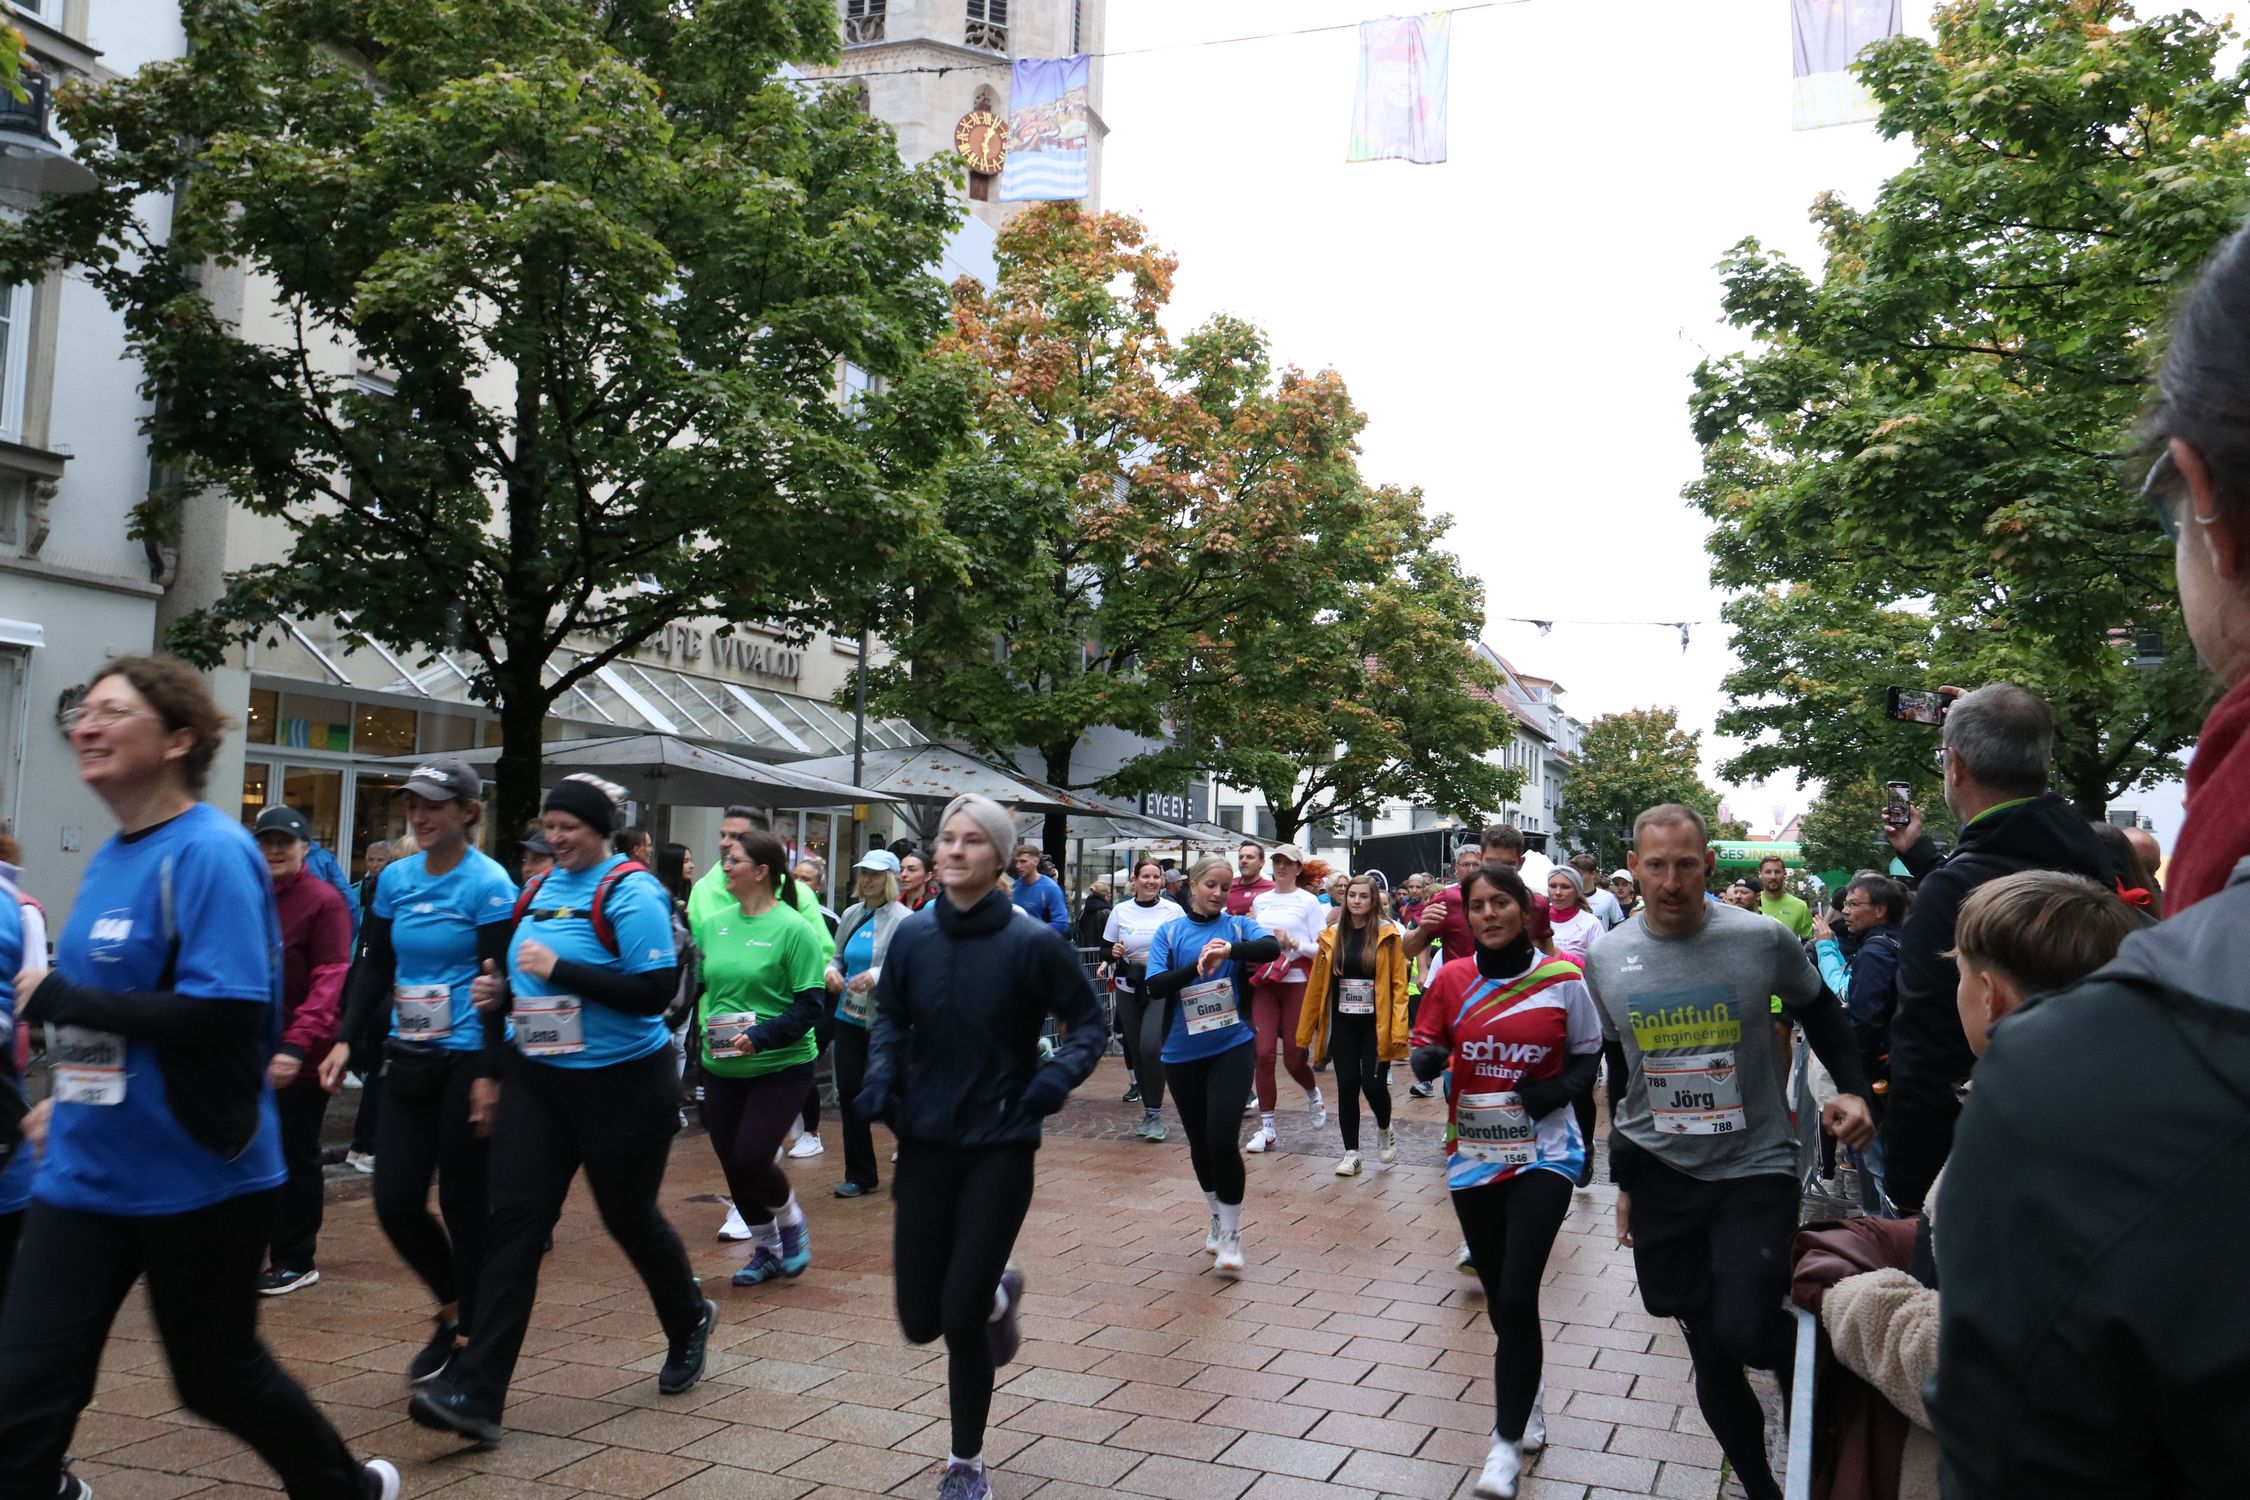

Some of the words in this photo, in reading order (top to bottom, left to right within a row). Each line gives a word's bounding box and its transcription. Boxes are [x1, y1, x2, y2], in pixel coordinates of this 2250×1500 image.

[709, 633, 803, 681] VIVALDI
[1147, 792, 1169, 816] EYE
[1345, 993, 1363, 1002] Gina
[1197, 1002, 1222, 1016] Gina
[1628, 1002, 1729, 1029] Goldfuß
[1654, 1027, 1739, 1045] engineering
[1461, 1034, 1552, 1063] schwer
[1647, 1077, 1667, 1088] 788
[1670, 1090, 1715, 1110] Jörg
[1458, 1122, 1529, 1140] Dorothee
[1711, 1121, 1733, 1132] 788
[1503, 1153, 1528, 1163] 1546
